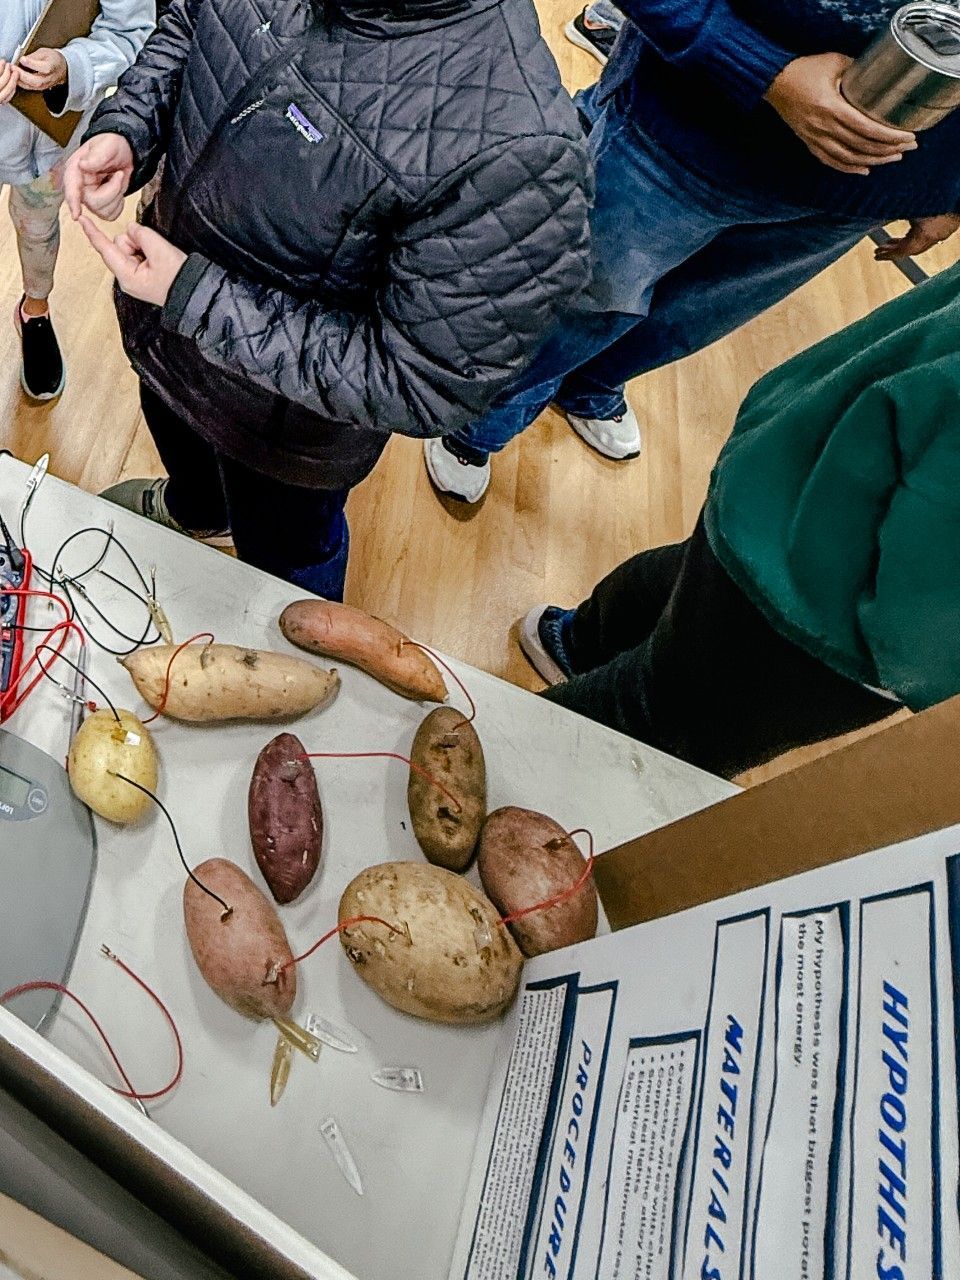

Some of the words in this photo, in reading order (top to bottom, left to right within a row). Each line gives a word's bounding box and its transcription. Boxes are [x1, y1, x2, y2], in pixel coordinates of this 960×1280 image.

[797, 922, 807, 950] the
[813, 919, 824, 944] My
[796, 954, 804, 997] most
[813, 949, 823, 1046] hypothesis
[810, 1052, 819, 1089] was
[809, 1095, 818, 1133] that
[543, 1039, 592, 1280] PROCEDURE
[700, 1014, 745, 1280] MATERIALS
[804, 1140, 816, 1214] biggest
